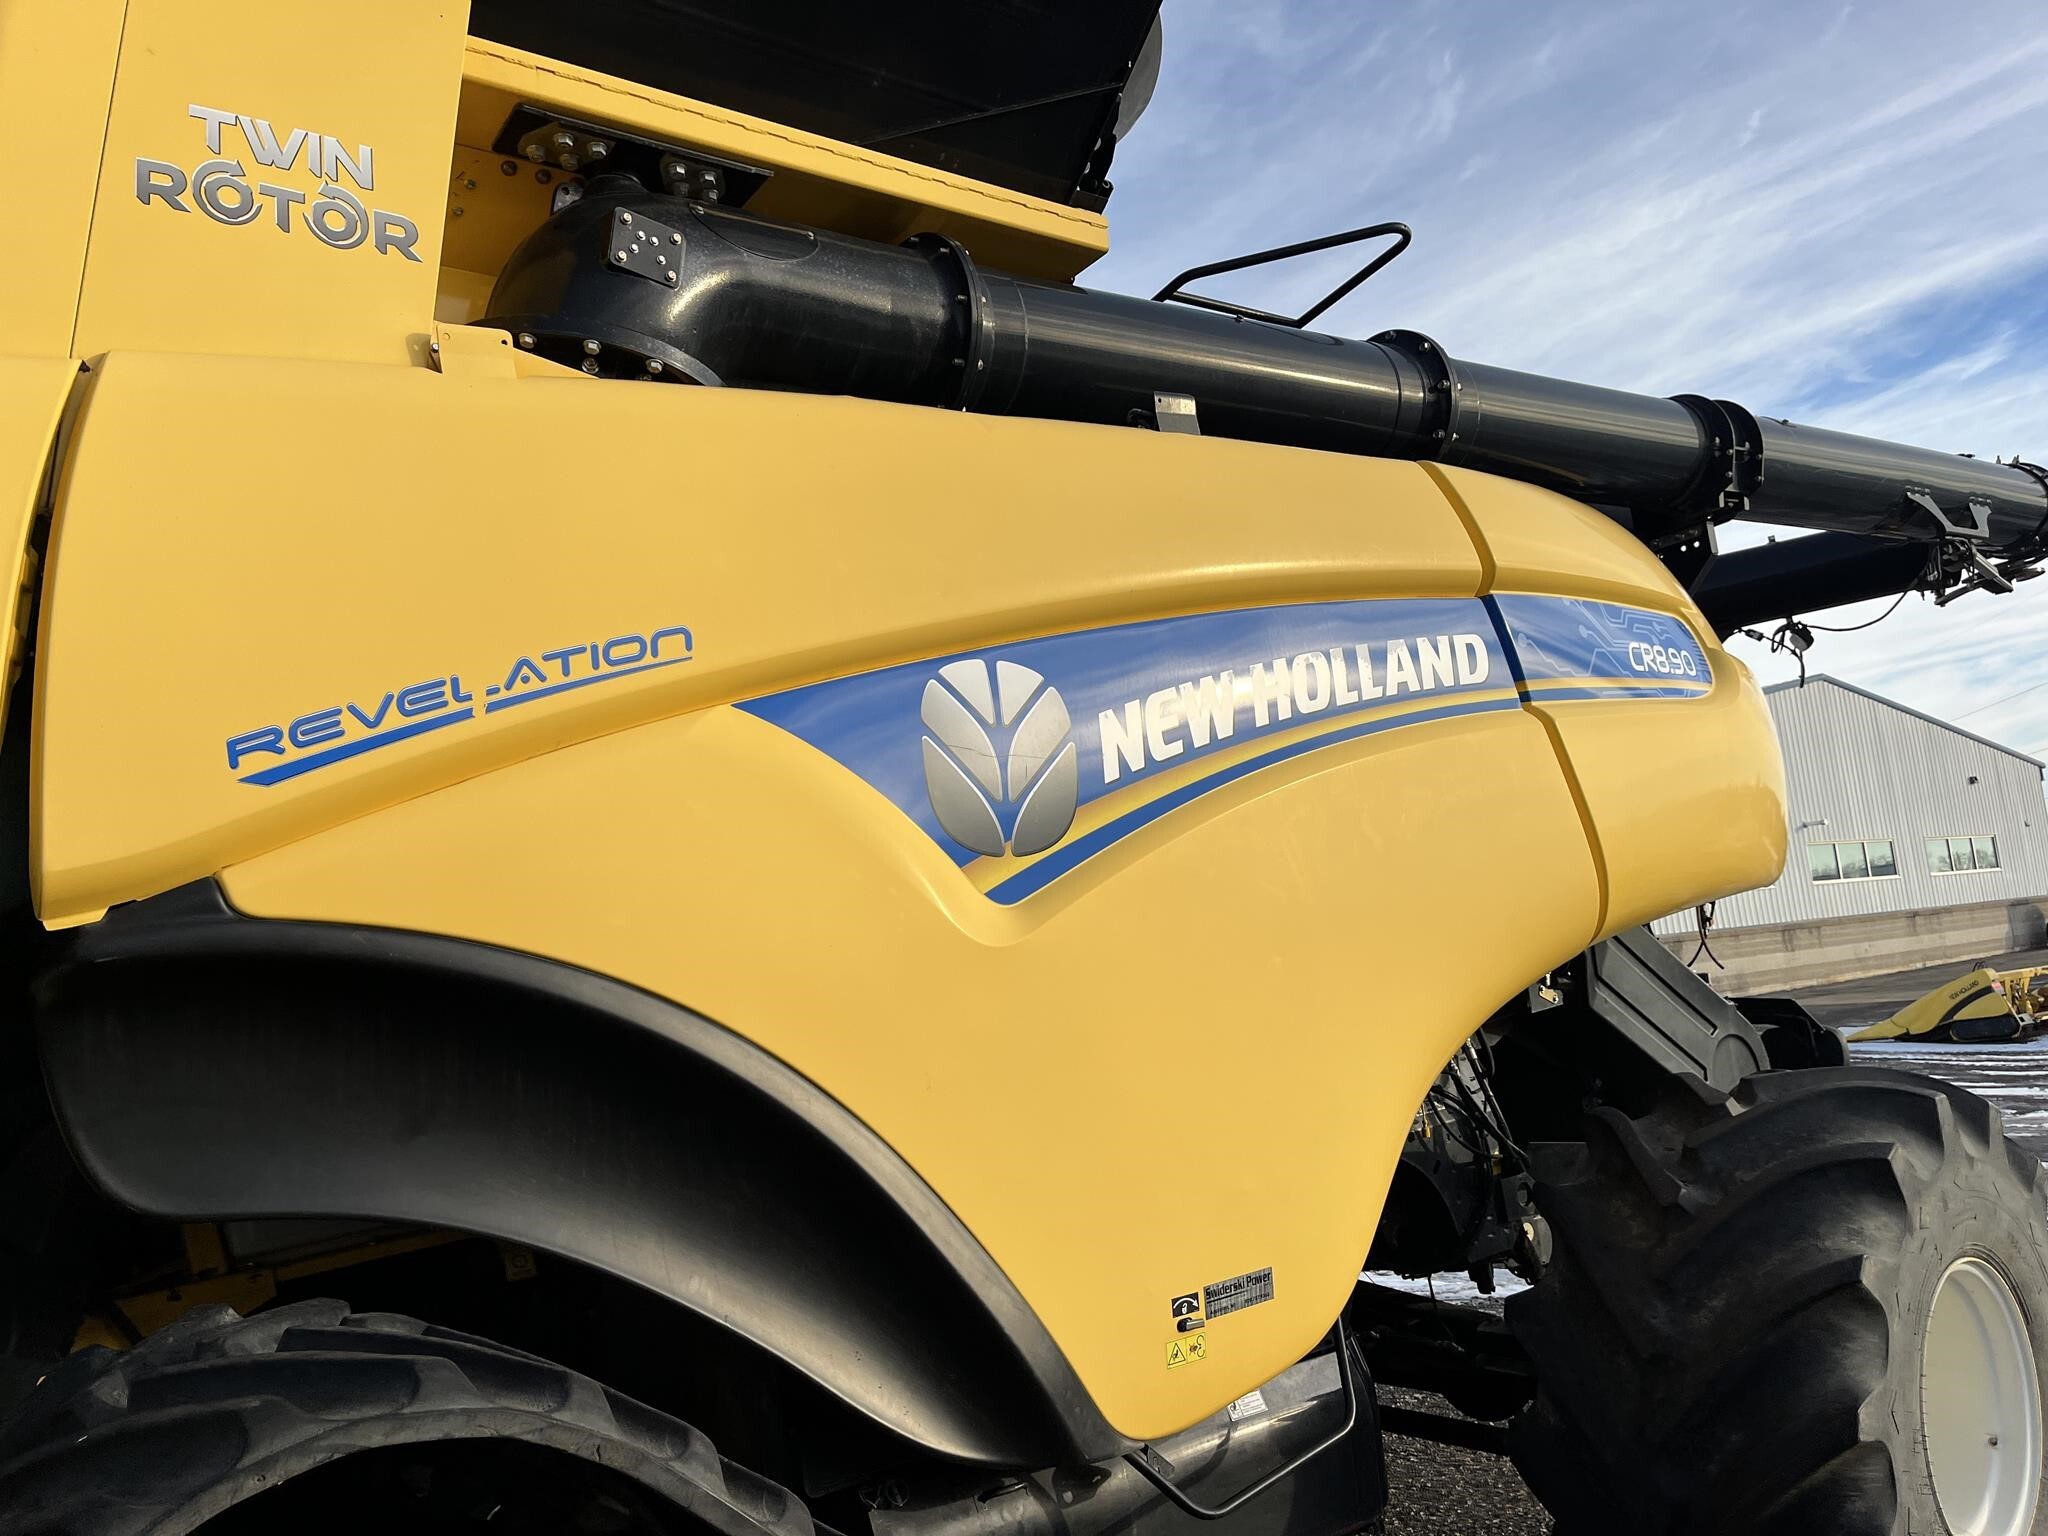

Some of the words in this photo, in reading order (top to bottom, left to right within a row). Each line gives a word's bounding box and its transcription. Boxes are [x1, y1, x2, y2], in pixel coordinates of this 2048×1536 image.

[188, 103, 374, 191] TWIN
[135, 157, 423, 263] ROTOR
[226, 625, 693, 770] REVELATION
[1628, 641, 1697, 677] CR8.90
[1098, 670, 1236, 784] NEW
[1249, 634, 1490, 729] HOLLAND
[1205, 1279, 1245, 1300] Swiderski
[1246, 1272, 1271, 1287] Power
